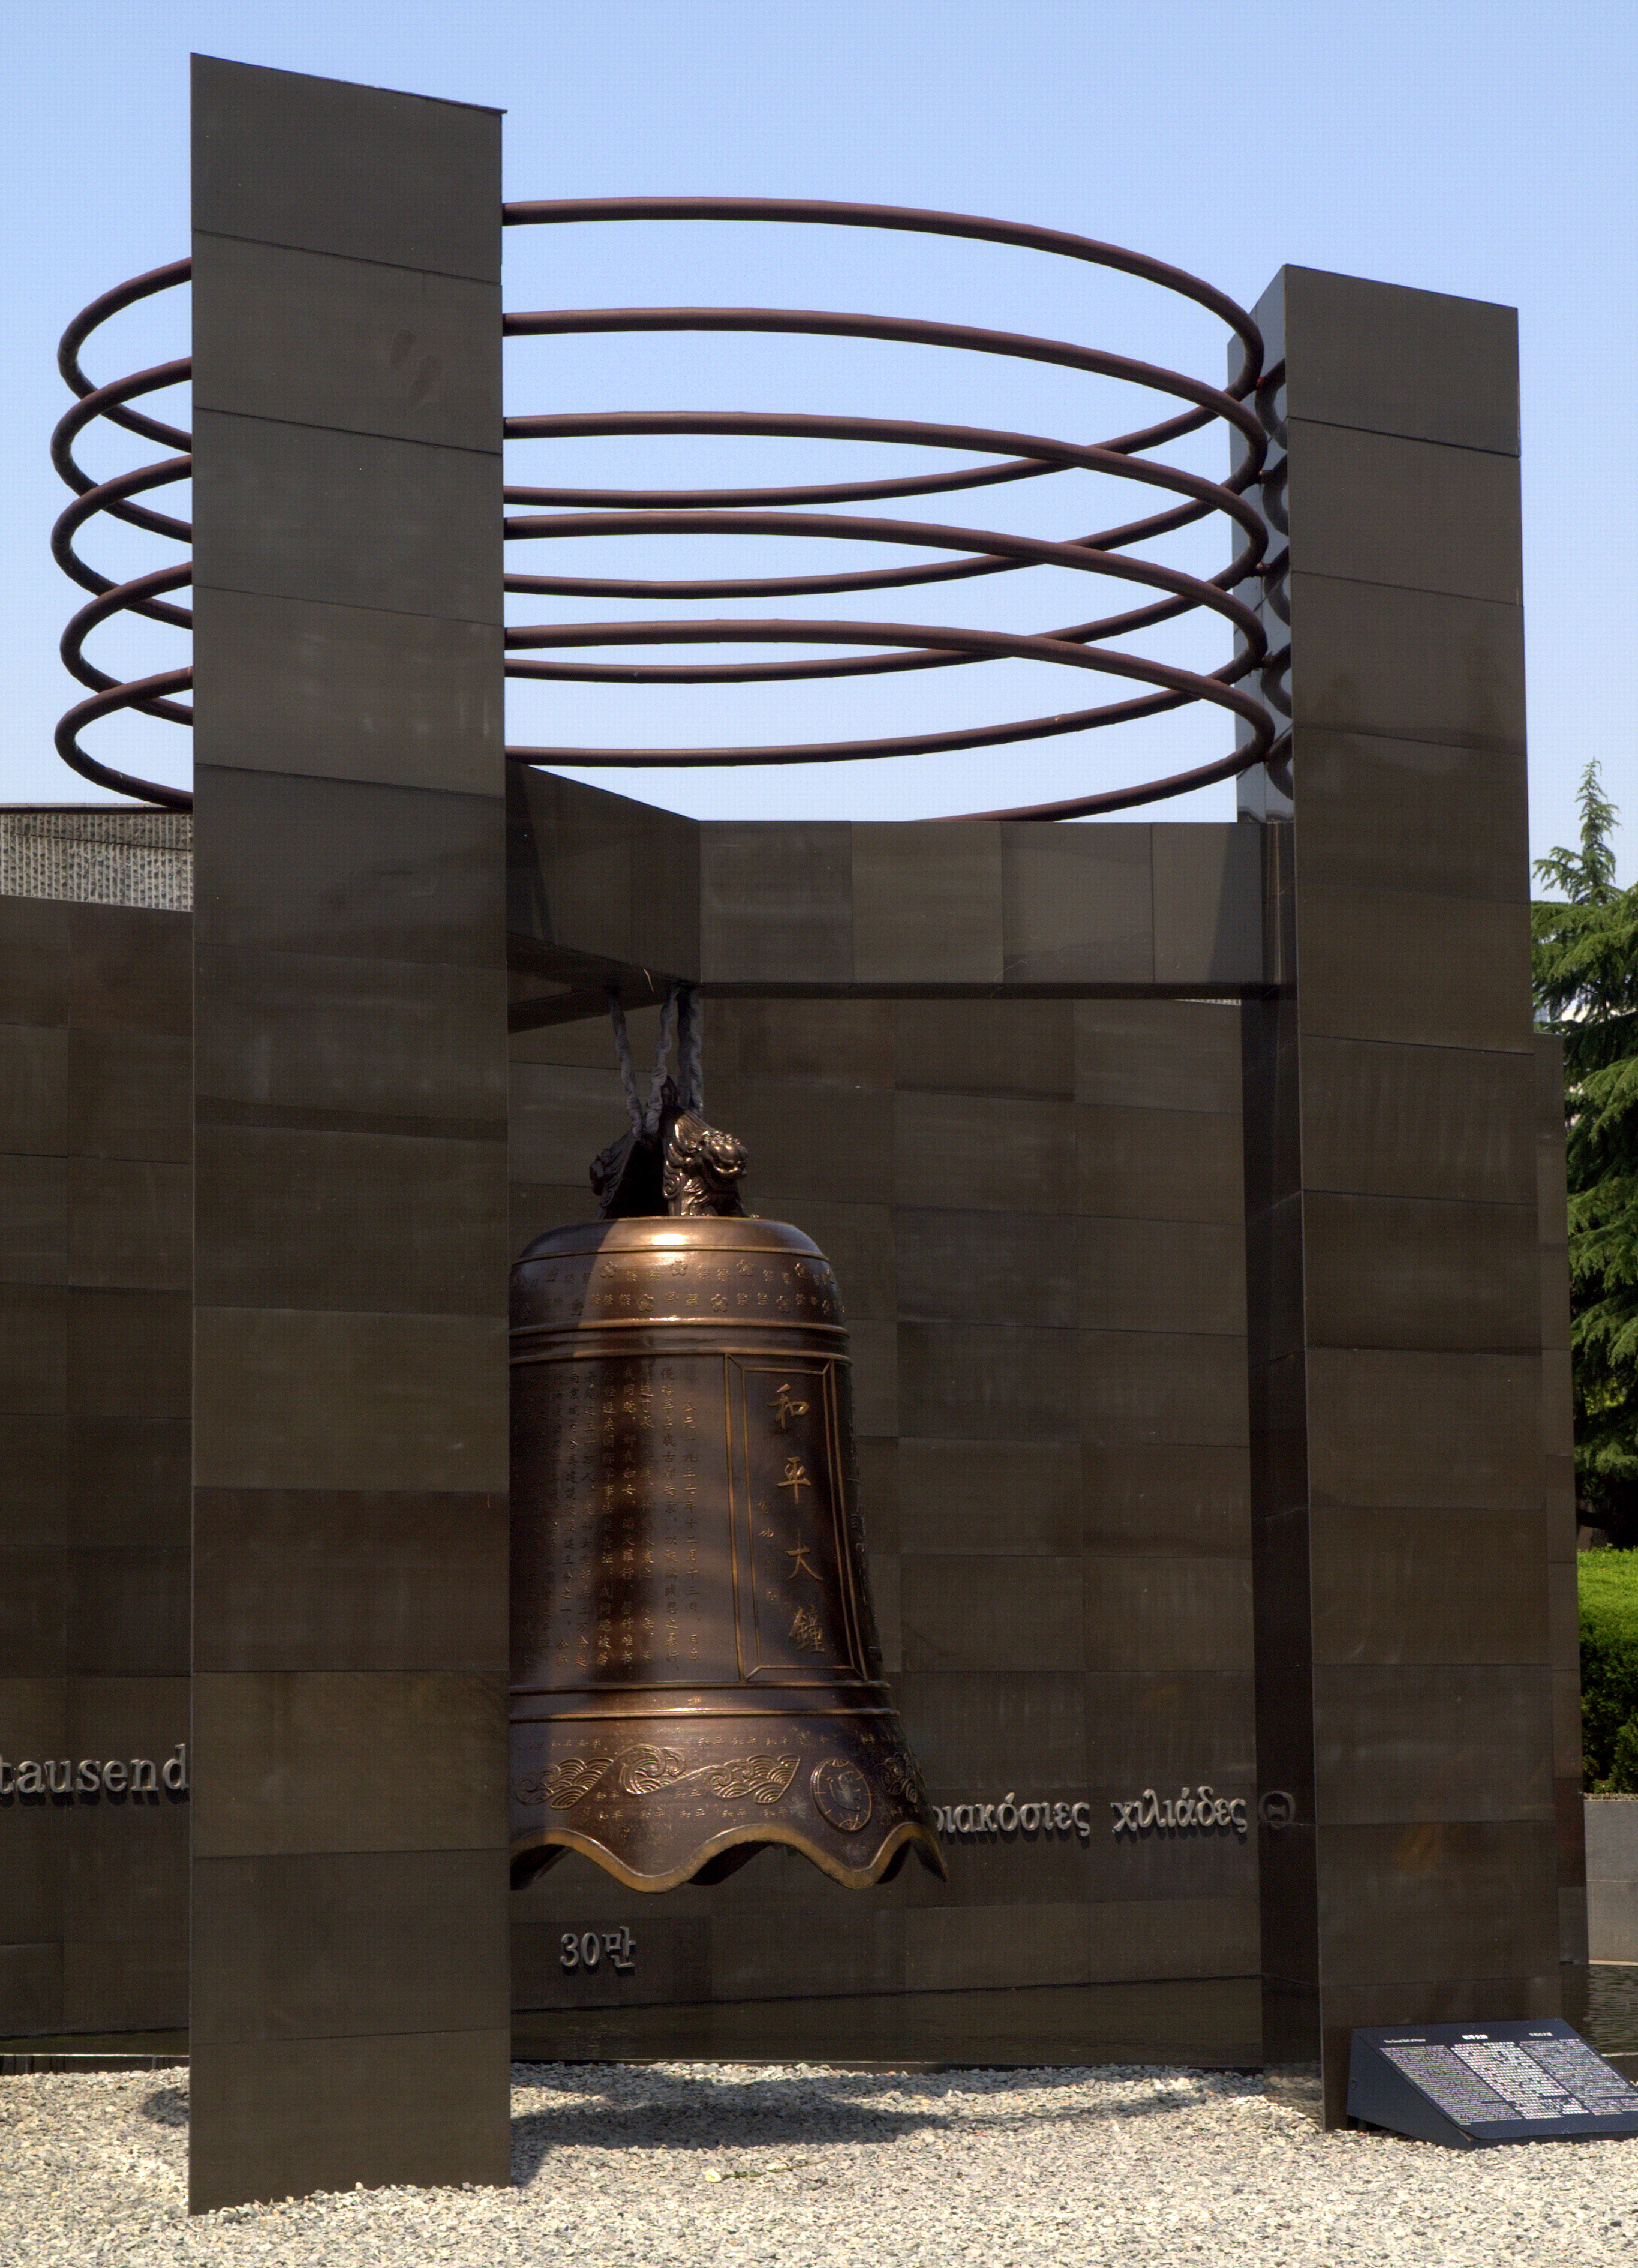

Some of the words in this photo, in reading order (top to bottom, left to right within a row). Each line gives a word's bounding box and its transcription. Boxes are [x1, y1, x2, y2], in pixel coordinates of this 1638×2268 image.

[717, 1268, 730, 1282] 祭
[763, 1269, 775, 1282] 祭
[618, 1293, 631, 1306] 祭
[736, 1293, 749, 1306] 祭
[757, 1293, 769, 1306] 祭
[767, 1384, 826, 1654] 和平大鐘
[0, 1743, 190, 1794] tausend
[1110, 1786, 1248, 1833] χιλιάδες
[560, 1925, 637, 1968] 30만
